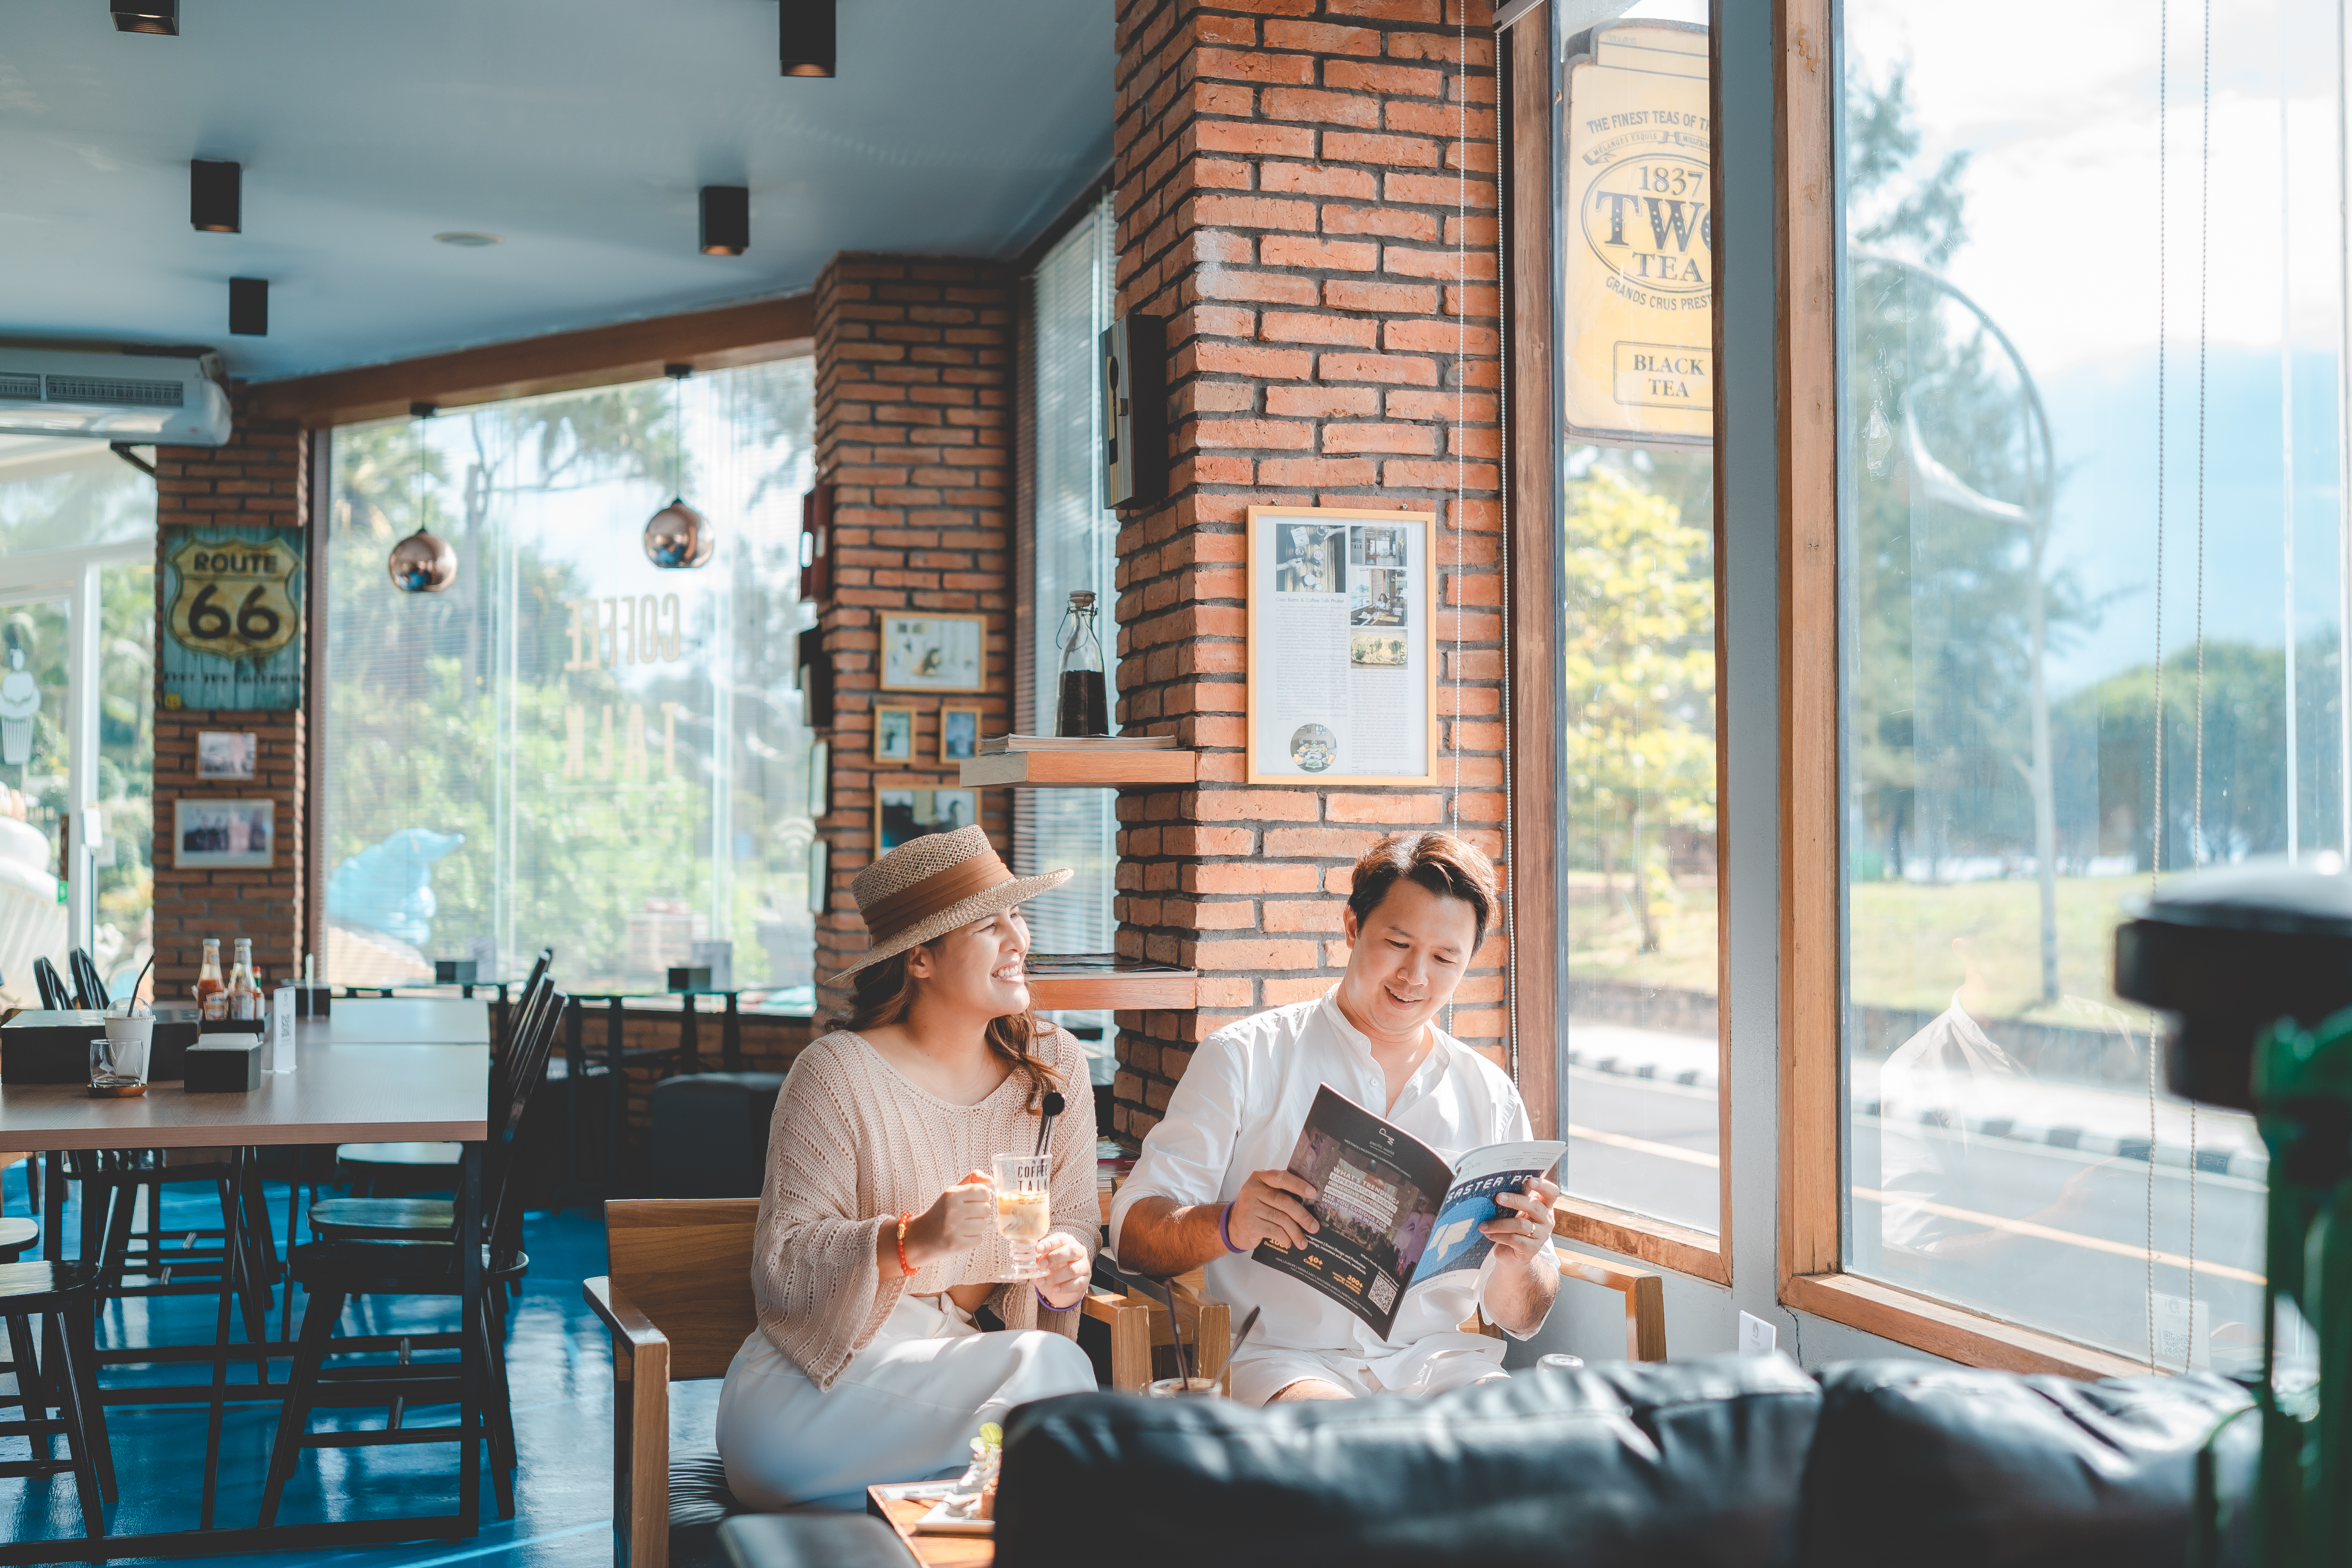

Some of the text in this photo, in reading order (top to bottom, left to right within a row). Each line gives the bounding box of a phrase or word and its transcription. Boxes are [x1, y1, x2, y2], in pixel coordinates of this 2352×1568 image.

[1587, 118, 1610, 134] THE
[1613, 111, 1648, 128] FINEST
[1652, 111, 1679, 124] TEAS
[1683, 113, 1697, 127] OF
[1631, 132, 1657, 143] EXQUIS
[1639, 165, 1704, 197] 1837
[1632, 252, 1704, 283] TEA
[1606, 276, 1646, 305] GRANDS
[1650, 296, 1676, 311] CRUS
[1633, 354, 1705, 376] BLACK
[1648, 379, 1689, 397] TEA
[194, 552, 278, 573] ROUTE
[188, 584, 279, 639] 66
[1018, 1164, 1048, 1178] COFFEE
[1018, 1180, 1048, 1192] TALK
[1332, 1175, 1396, 1211] EXPERIENTIAL EVENTS
[1334, 1167, 1399, 1205] WHAT'S TRENDING?
[1327, 1187, 1344, 1198] UNIQUE
[1355, 1200, 1374, 1213] UNUSUAL
[1375, 1211, 1390, 1223] VENUES
[1328, 1180, 1393, 1218] IMMERSIVE EXPERIENCES
[1322, 1197, 1339, 1207] WHAT
[1348, 1209, 1362, 1220] HAVE
[1369, 1220, 1387, 1234] STORE?
[1337, 1198, 1349, 1207] YOU
[1350, 1205, 1375, 1221] CURIOUS
[1376, 1219, 1387, 1229] FOR
[1264, 1241, 1288, 1255] Destinations
[1334, 1247, 1345, 1256] Design
[1350, 1257, 1366, 1270] Production
[1303, 1258, 1321, 1270] Countries
[1308, 1255, 1323, 1265] 40+
[1332, 1271, 1346, 1281] meetings
[1347, 1274, 1363, 1289] 200+
